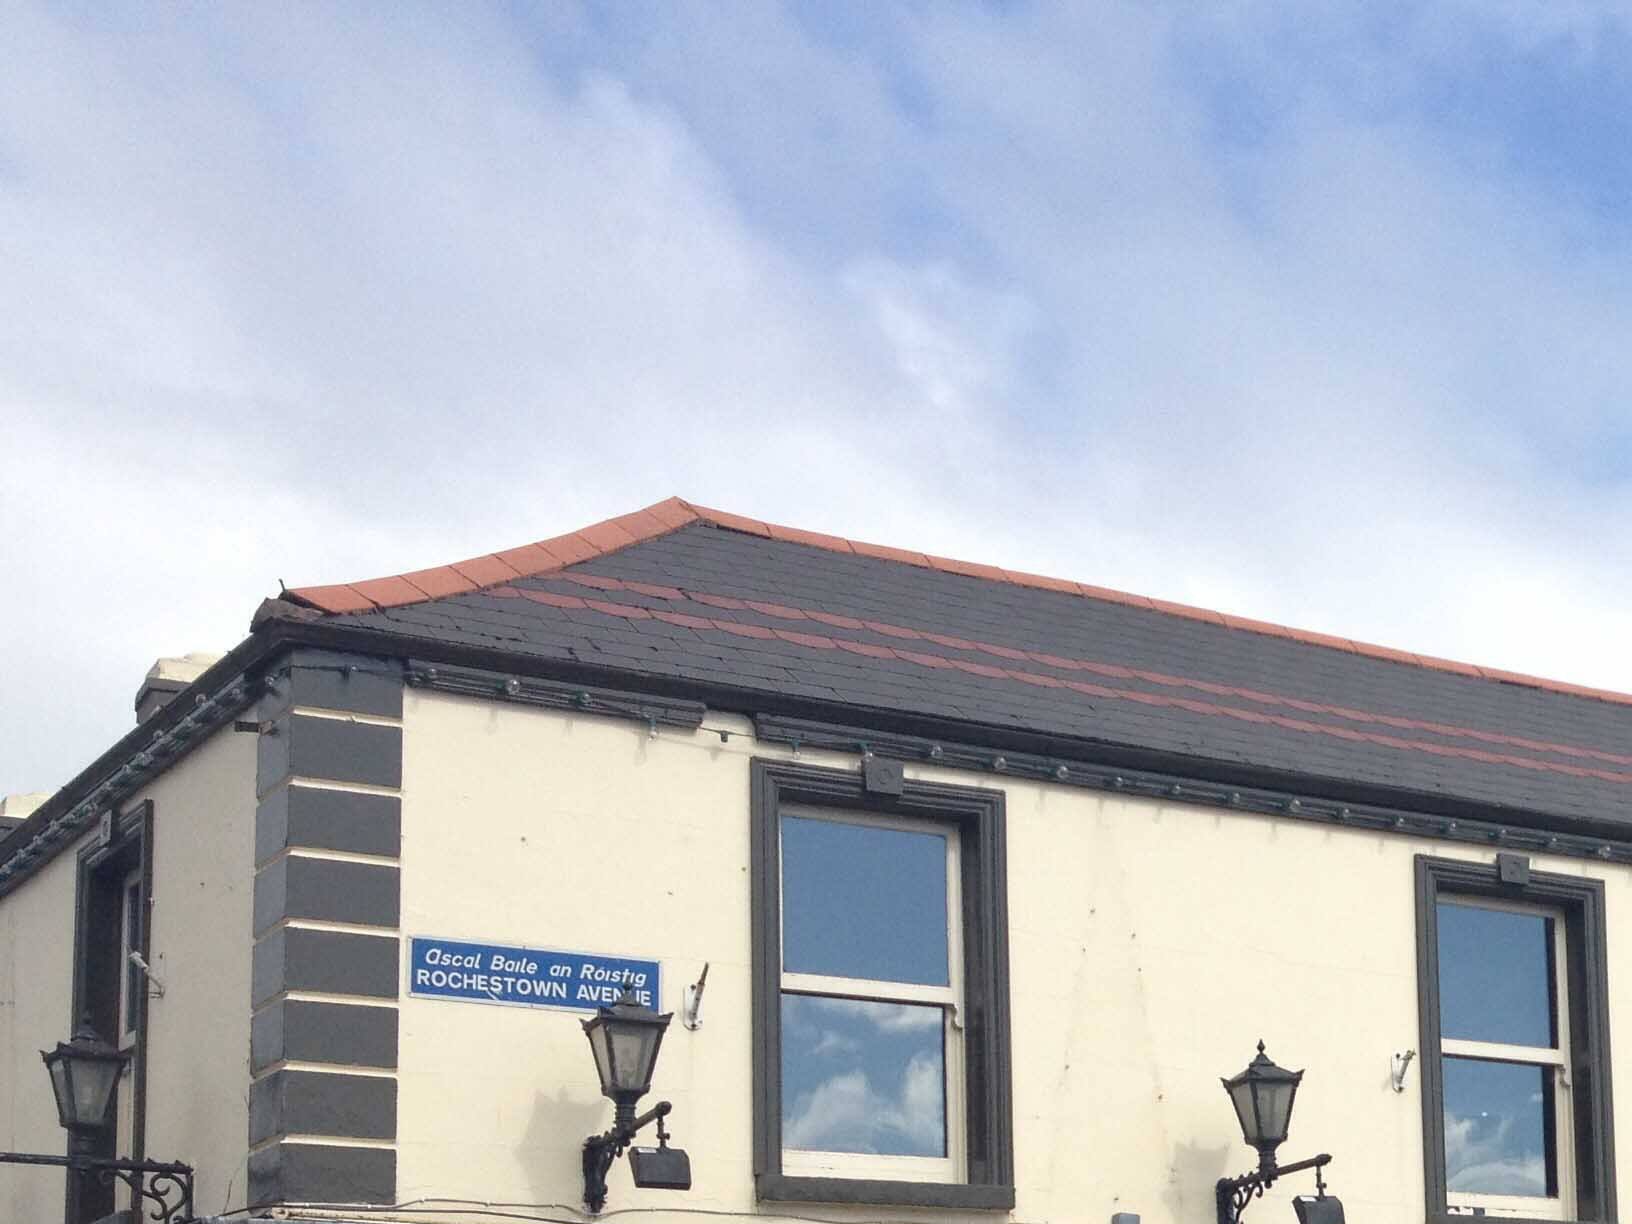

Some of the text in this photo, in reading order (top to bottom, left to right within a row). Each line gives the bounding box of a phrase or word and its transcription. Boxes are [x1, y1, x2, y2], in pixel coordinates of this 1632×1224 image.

[490, 955, 538, 974] Baile
[549, 964, 572, 978] an
[416, 968, 567, 998] ROCHESTOWN
